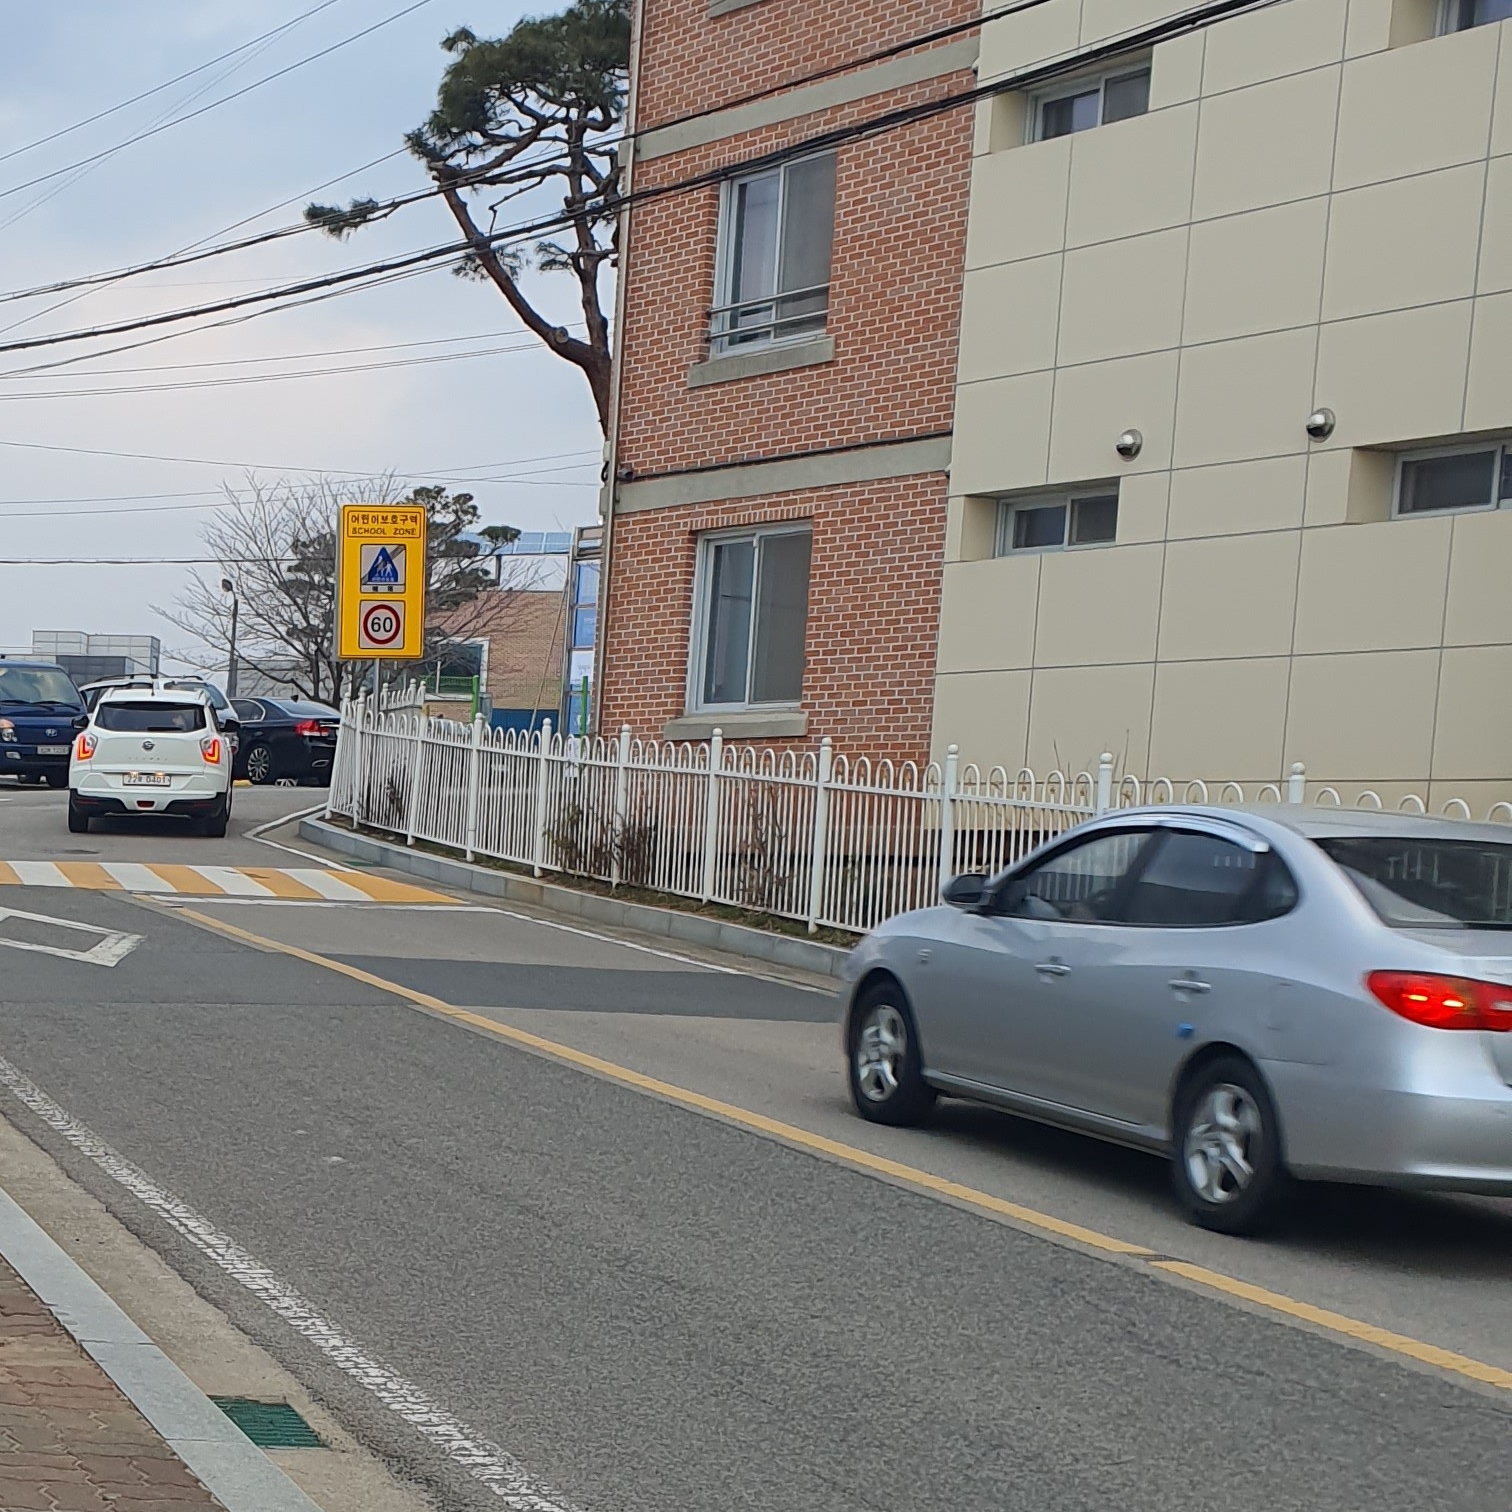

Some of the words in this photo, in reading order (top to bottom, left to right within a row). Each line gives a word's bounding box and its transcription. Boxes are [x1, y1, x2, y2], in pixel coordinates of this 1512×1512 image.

[351, 514, 418, 525] 어린이보호구역
[351, 527, 387, 535] SCHOOL
[392, 527, 417, 536] ZONE
[371, 617, 393, 632] 60
